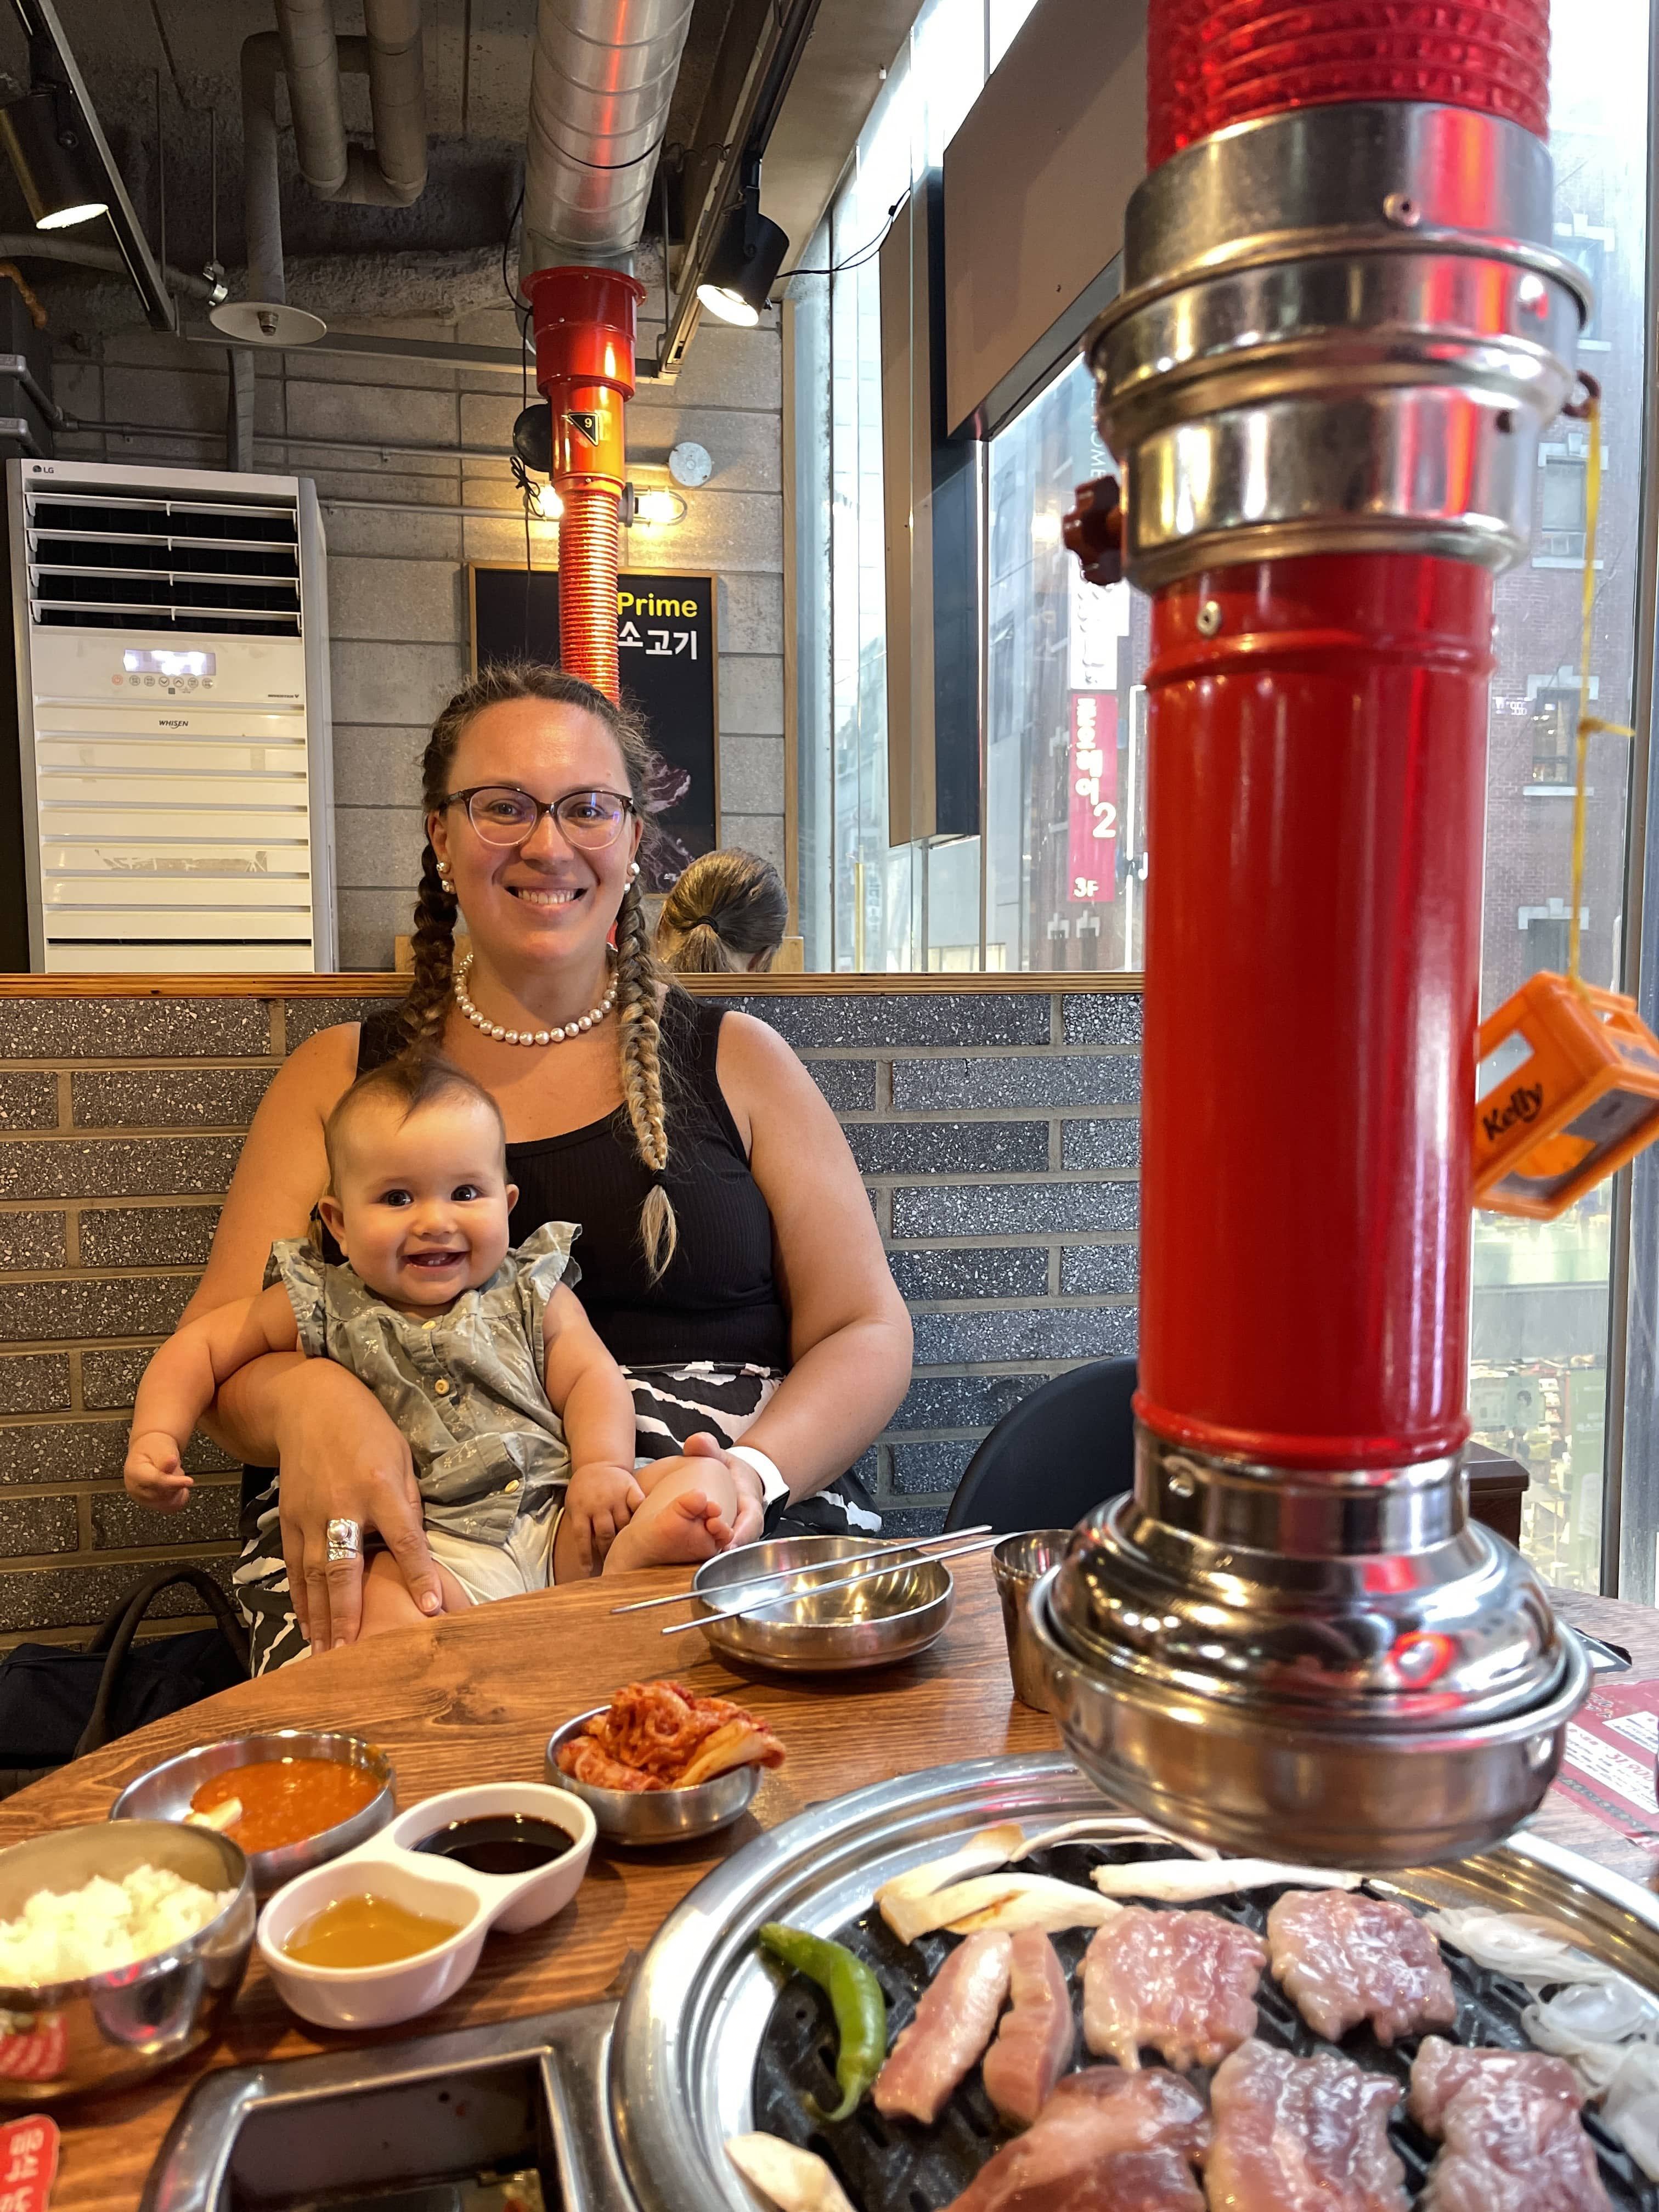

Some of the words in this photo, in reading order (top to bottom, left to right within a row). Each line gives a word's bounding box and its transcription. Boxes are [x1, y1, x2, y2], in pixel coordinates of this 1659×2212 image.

[584, 417, 592, 428] 9
[617, 592, 697, 617] Prime
[618, 621, 697, 660] 소고기
[159, 720, 189, 729] WHISEN
[1074, 877, 1099, 898] 3F
[1482, 1082, 1543, 1141] Kelly
